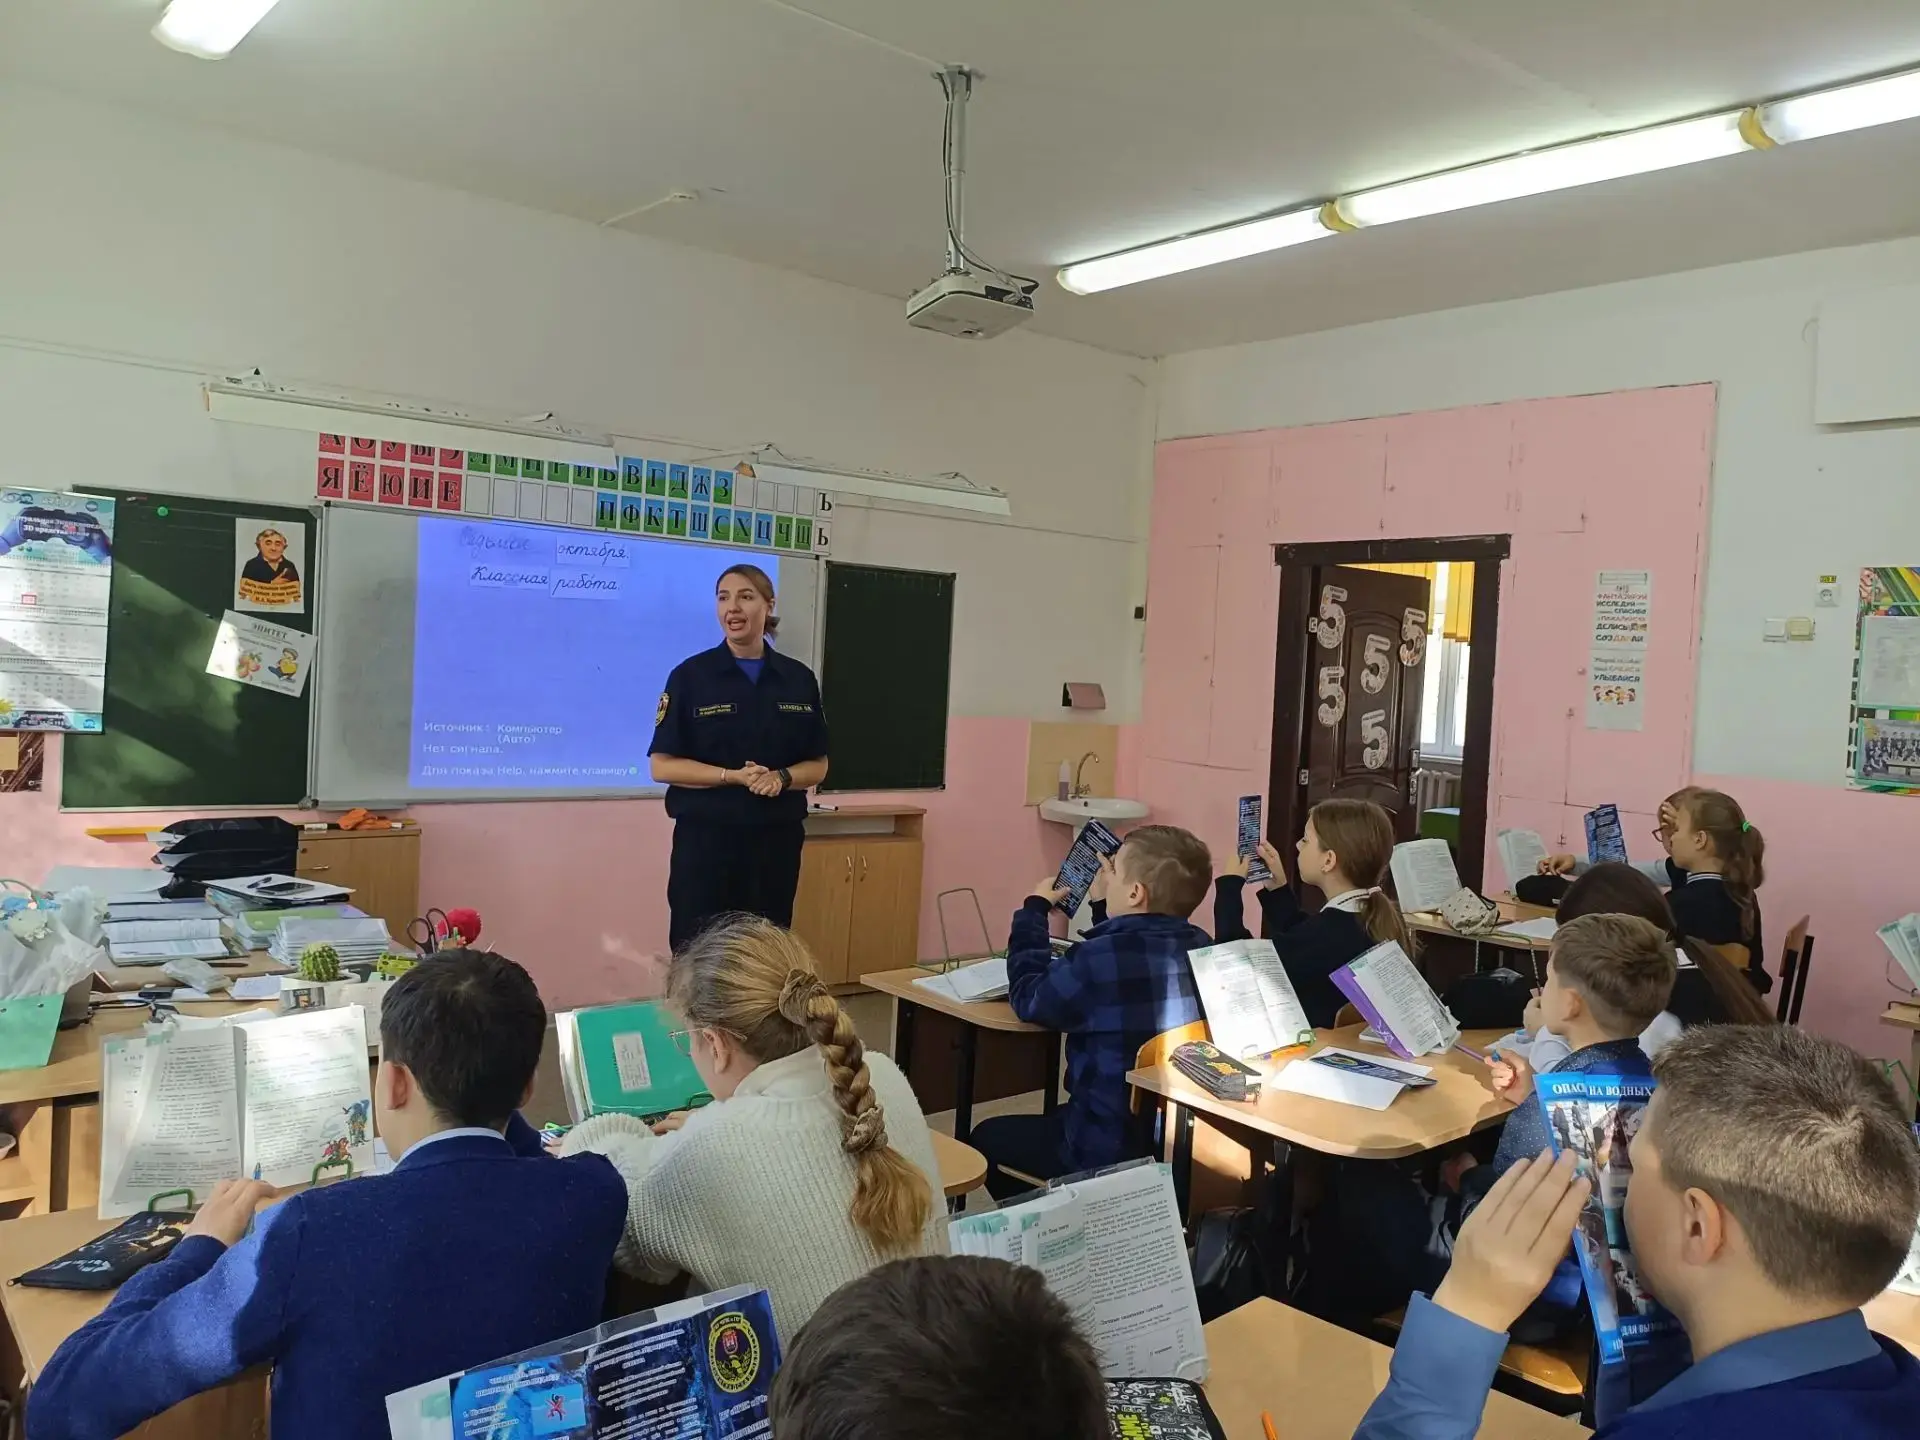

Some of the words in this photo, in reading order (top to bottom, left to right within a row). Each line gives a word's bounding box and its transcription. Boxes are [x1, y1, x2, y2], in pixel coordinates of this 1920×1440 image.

[471, 565, 549, 585] Классная
[497, 724, 562, 735] Компьютер
[497, 734, 536, 745] (Авто)
[423, 744, 445, 753] Нет
[422, 765, 448, 776] Для
[451, 767, 494, 776] показа
[530, 767, 579, 776] нажмите
[582, 768, 628, 778] клавишу
[1589, 1085, 1604, 1096] НА
[1606, 1086, 1652, 1097] ВОДНЫХ
